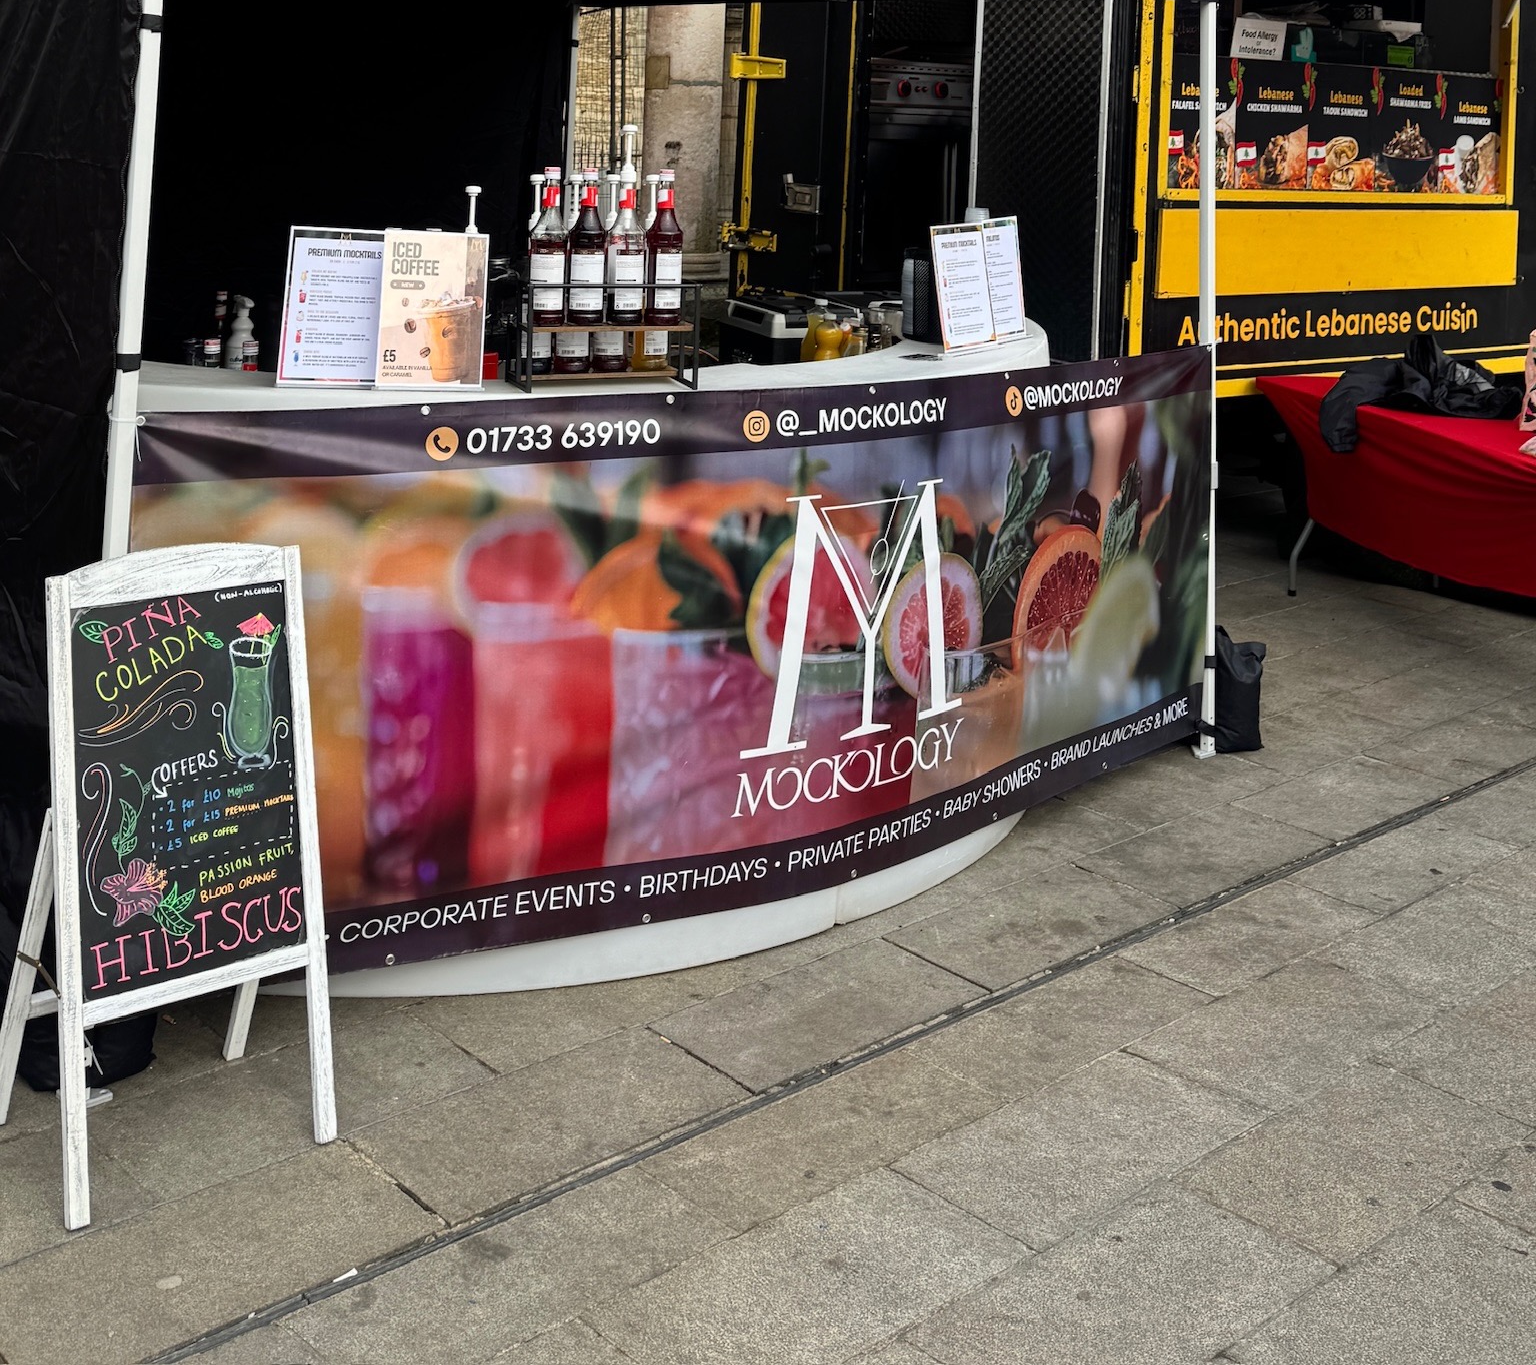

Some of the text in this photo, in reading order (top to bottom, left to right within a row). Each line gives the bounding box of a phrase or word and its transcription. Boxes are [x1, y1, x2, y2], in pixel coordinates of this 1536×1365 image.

[1241, 28, 1279, 42] Food Allergy
[1238, 45, 1276, 56] Intolerance?
[1181, 82, 1220, 97] Lebae
[1259, 86, 1294, 101] Lebanese
[1330, 90, 1363, 105] Lebanese
[1399, 83, 1423, 96] Loaded
[1172, 100, 1194, 110] FALAFEL
[1247, 103, 1302, 113] CHICKEN SHAWARMA
[1341, 107, 1368, 117] SANDWICH
[1458, 101, 1488, 114] Lebanese
[308, 248, 382, 260] PREMIUM MOCKTAILS
[393, 242, 422, 258] ICED
[391, 259, 440, 276] COFFEE
[1178, 301, 1478, 346] Athentic Lebanese Cuisin
[383, 349, 396, 363] £5
[1024, 376, 1123, 410] @MOCKOLOGY
[776, 397, 947, 436] @_MOCKOLOGY
[466, 418, 661, 454] 01733 639190
[95, 624, 208, 702] COLADA
[160, 749, 218, 782] OFFERS
[731, 717, 965, 818] MOCKOLOGY
[167, 783, 255, 813] 2 for £10 Mojitos
[166, 819, 175, 833] 2
[182, 818, 196, 832] for
[203, 809, 221, 823] £15
[224, 803, 260, 817] PREMIUM
[339, 697, 1189, 943] CORPORATE EVENTS BIRTHDAYS PRIVATE PARTIES BABY SHOWERS BRAND LAUNCHES & MORE
[167, 825, 239, 852] £5 ICED COFFEE
[199, 855, 252, 886] PASSION
[199, 869, 278, 903] BLOOD ORANGE
[90, 886, 301, 990] HIBISCUS
